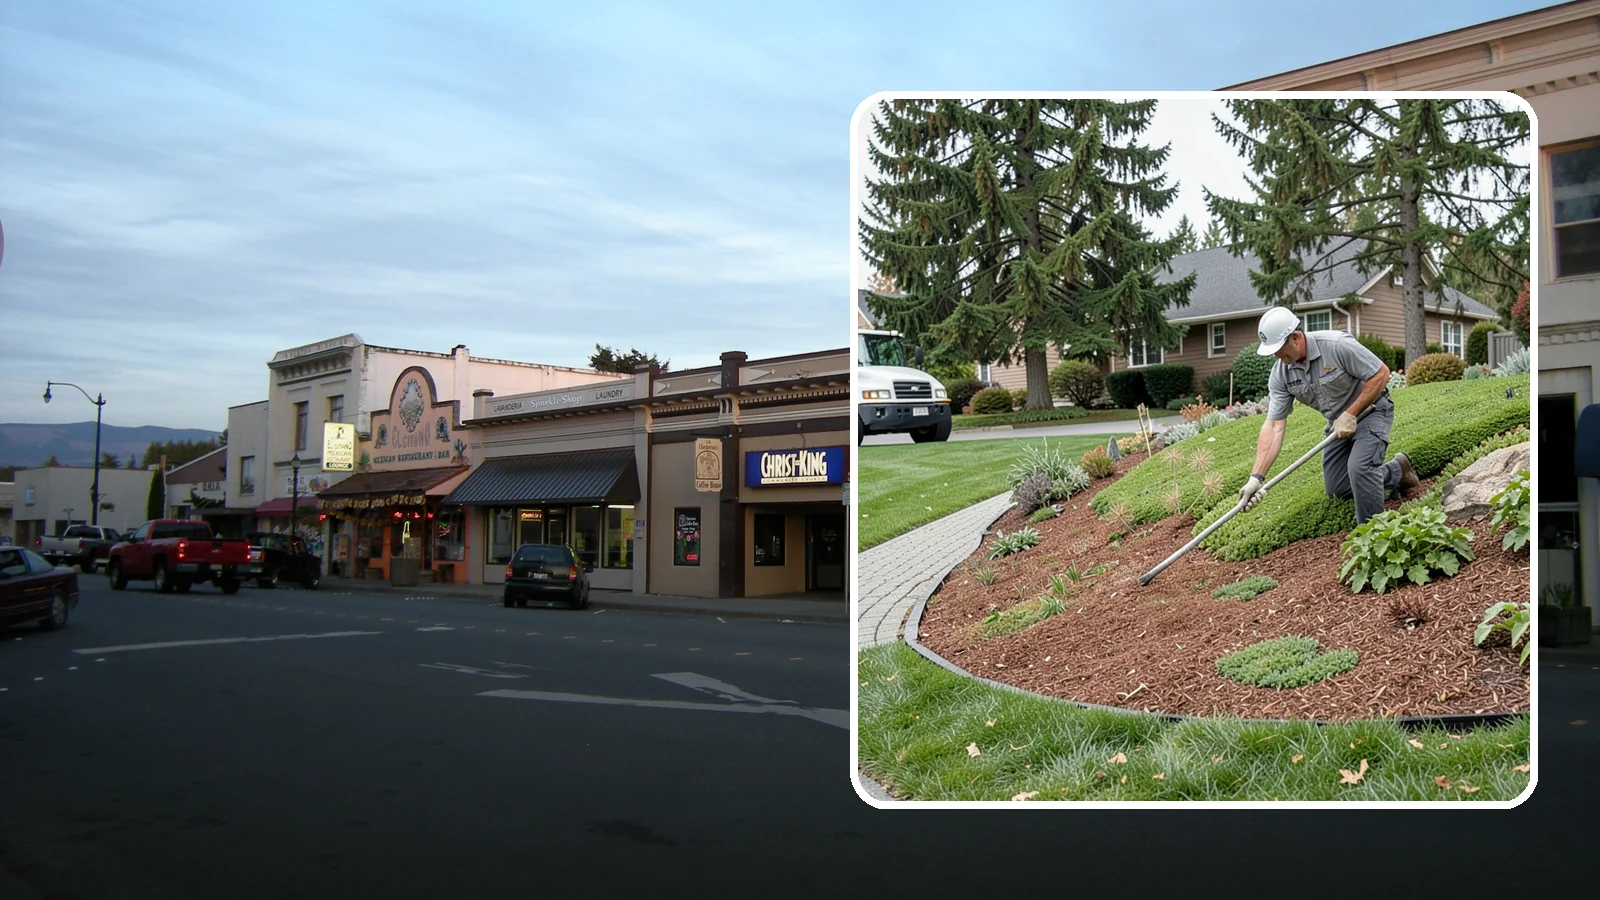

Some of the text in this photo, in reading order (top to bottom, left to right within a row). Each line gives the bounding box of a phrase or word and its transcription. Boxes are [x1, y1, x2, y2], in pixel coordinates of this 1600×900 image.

[595, 389, 623, 400] LAUNDRY
[493, 402, 522, 412] LAVANDERIA
[531, 394, 582, 408] Sparkle Shop
[397, 452, 433, 462] RESTAURANT
[438, 450, 450, 458] BAR
[761, 450, 827, 478] CHRIST KING
